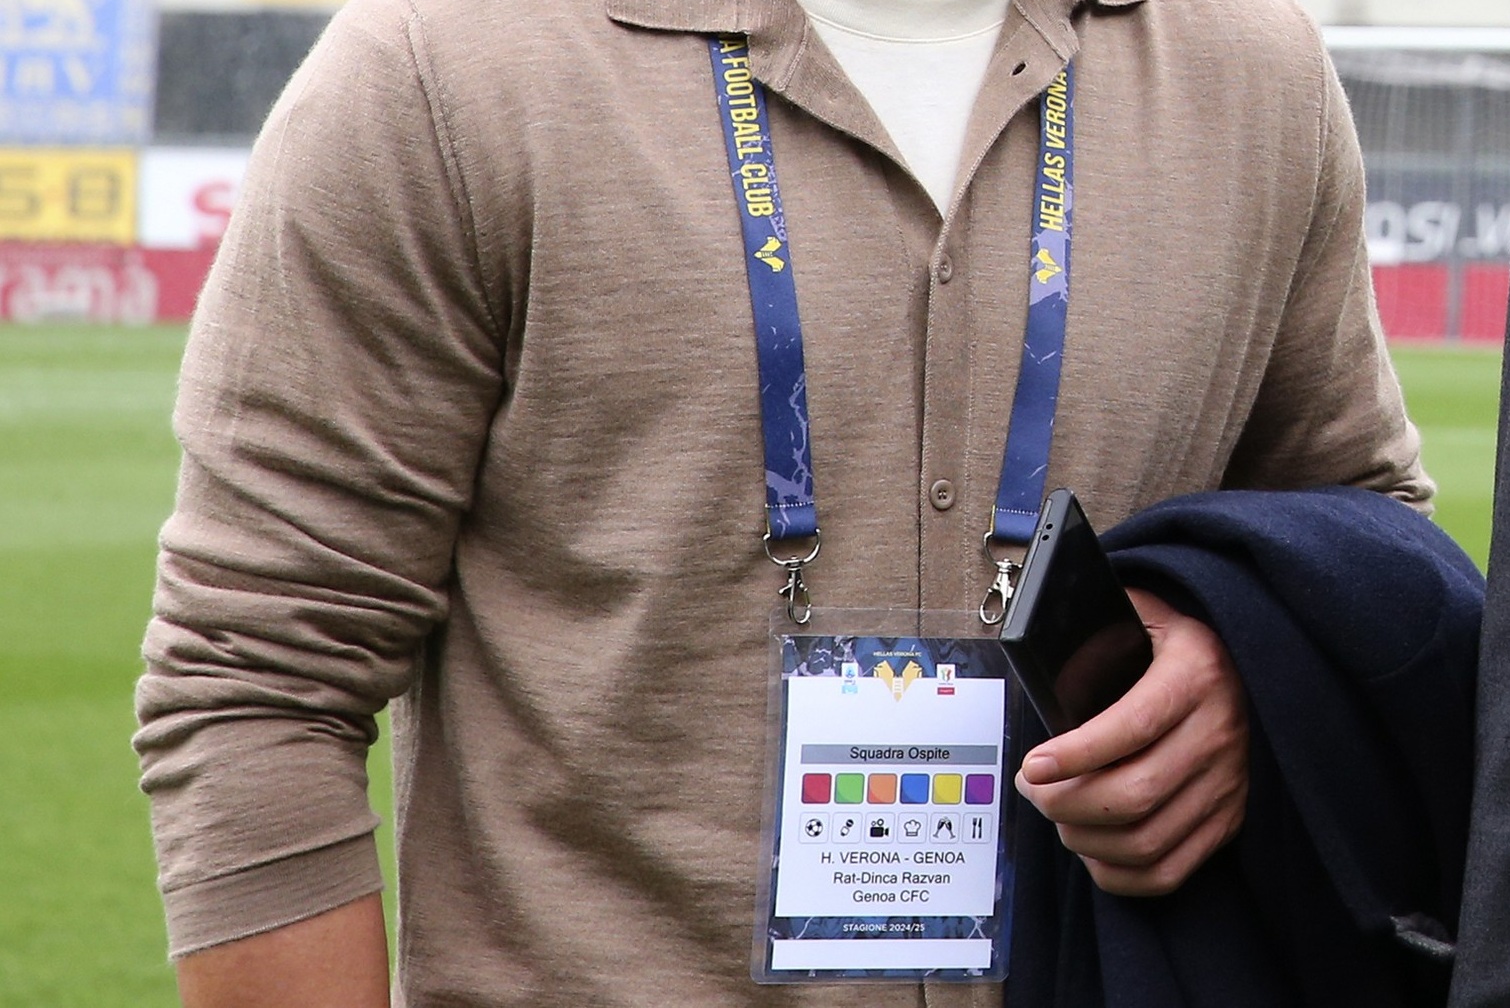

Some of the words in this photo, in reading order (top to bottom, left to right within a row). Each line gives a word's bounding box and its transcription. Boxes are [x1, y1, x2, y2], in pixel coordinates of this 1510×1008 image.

[721, 57, 763, 161] FOOTBALL
[1044, 70, 1068, 150] VERONA
[740, 163, 774, 218] CLUB
[1038, 151, 1066, 232] HELLAS
[850, 747, 904, 761] Squadra
[908, 747, 950, 761] Ospite
[821, 852, 835, 864] H.
[840, 852, 901, 864] VERONA
[913, 852, 965, 864] GENOA
[833, 872, 898, 885] Rat-Dinca
[902, 872, 951, 885] Razvan
[853, 890, 897, 903] Genoa
[900, 890, 930, 903] CFC
[843, 923, 888, 932] STAGIONE
[889, 923, 925, 933] 2024/25
